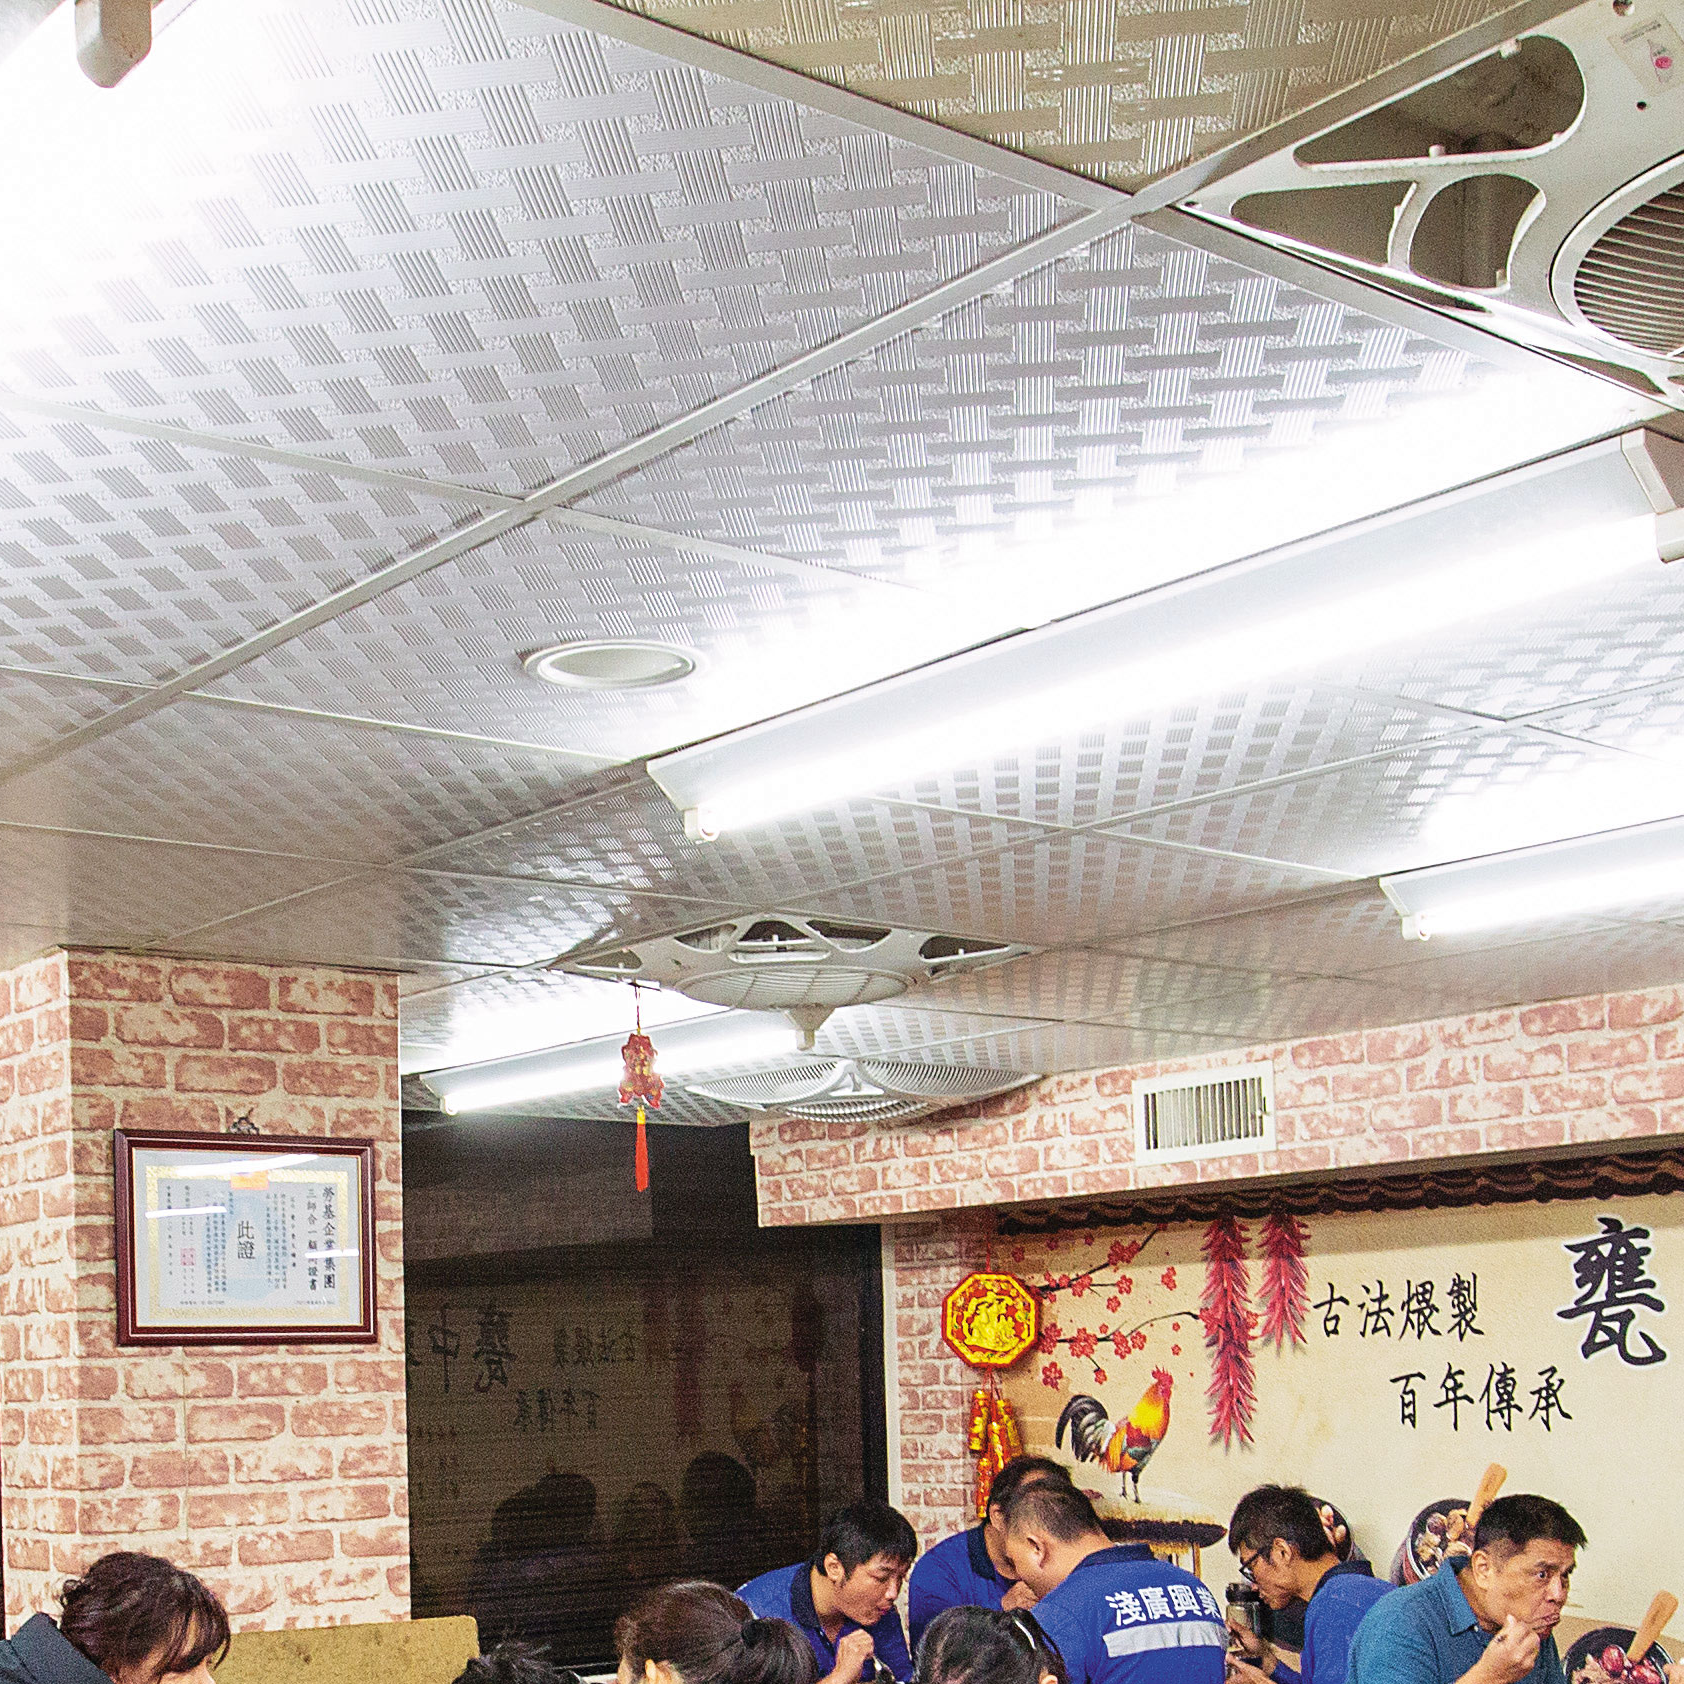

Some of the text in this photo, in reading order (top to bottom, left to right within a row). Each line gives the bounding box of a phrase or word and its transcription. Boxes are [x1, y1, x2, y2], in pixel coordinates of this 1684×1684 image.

[237, 1220, 256, 1260] 此證
[1312, 1272, 1485, 1342] 古法煨製
[1389, 1361, 1573, 1432] 百年傳承
